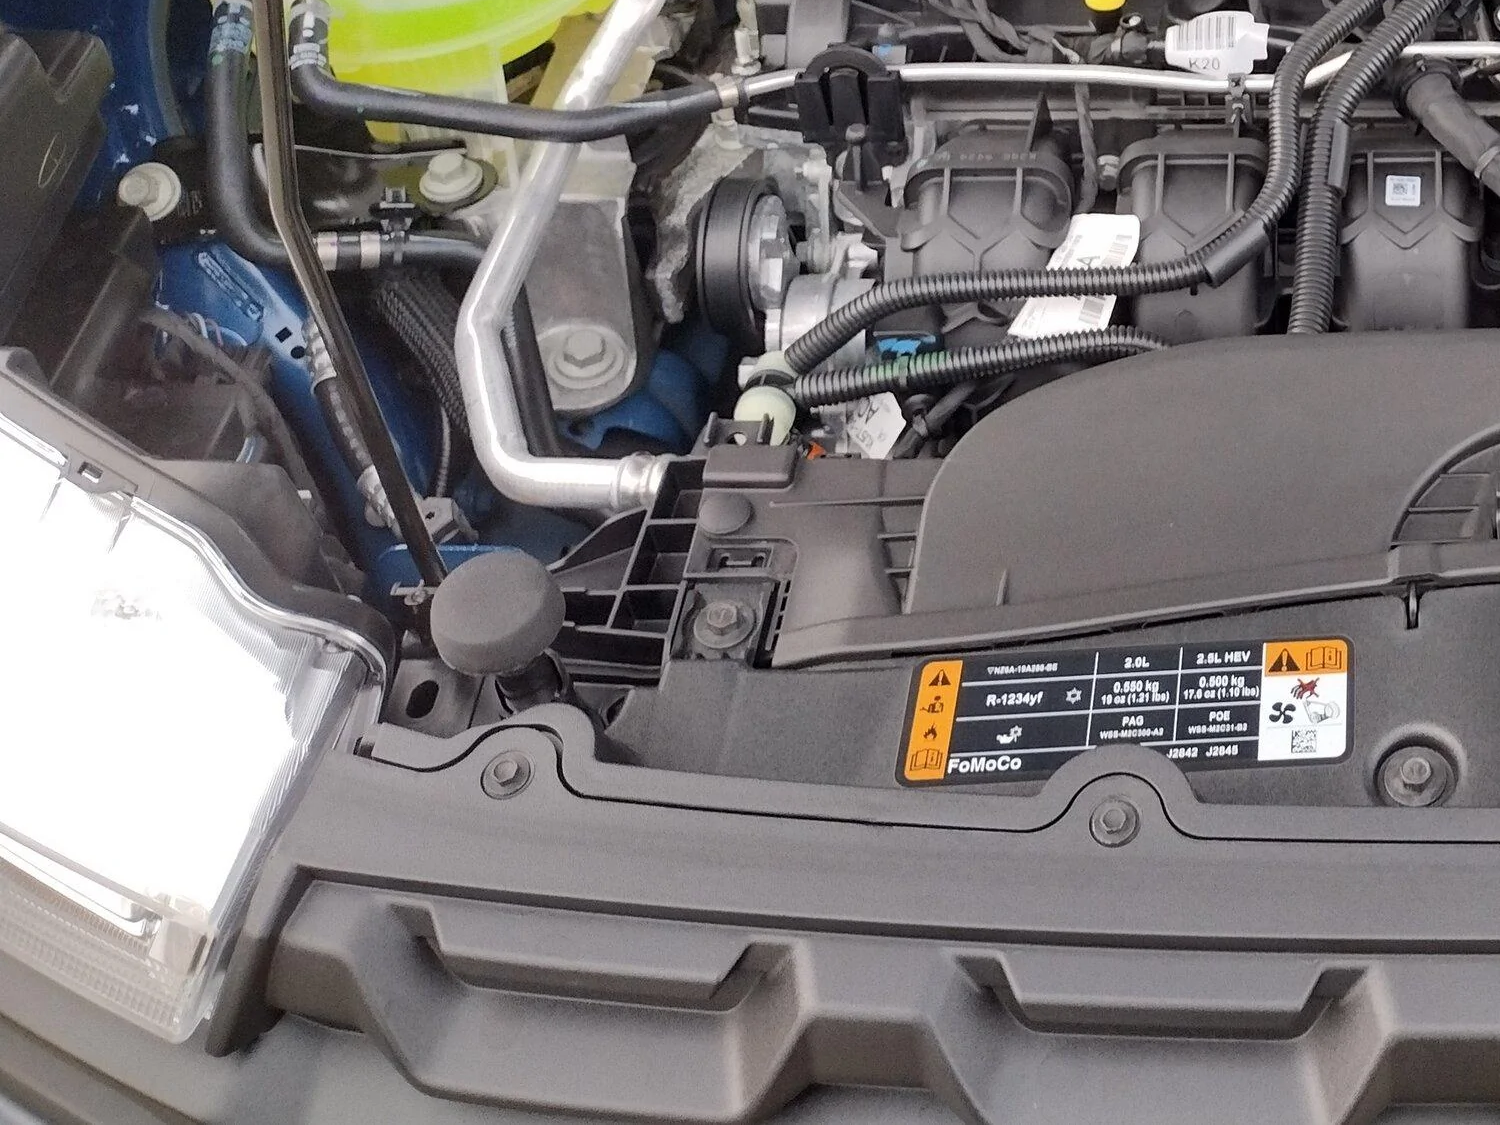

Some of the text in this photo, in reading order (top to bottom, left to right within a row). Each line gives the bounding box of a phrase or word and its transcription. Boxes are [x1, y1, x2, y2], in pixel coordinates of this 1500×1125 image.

[1188, 57, 1221, 71] K20
[1124, 656, 1150, 669] 2.0L
[1224, 650, 1251, 663] HEV
[1145, 679, 1160, 693] kg
[1231, 674, 1245, 687] kg
[986, 691, 1044, 707] R-1234yf
[1122, 715, 1144, 727] PAG
[1208, 710, 1231, 722] POE
[947, 755, 1022, 774] FoMoCo
